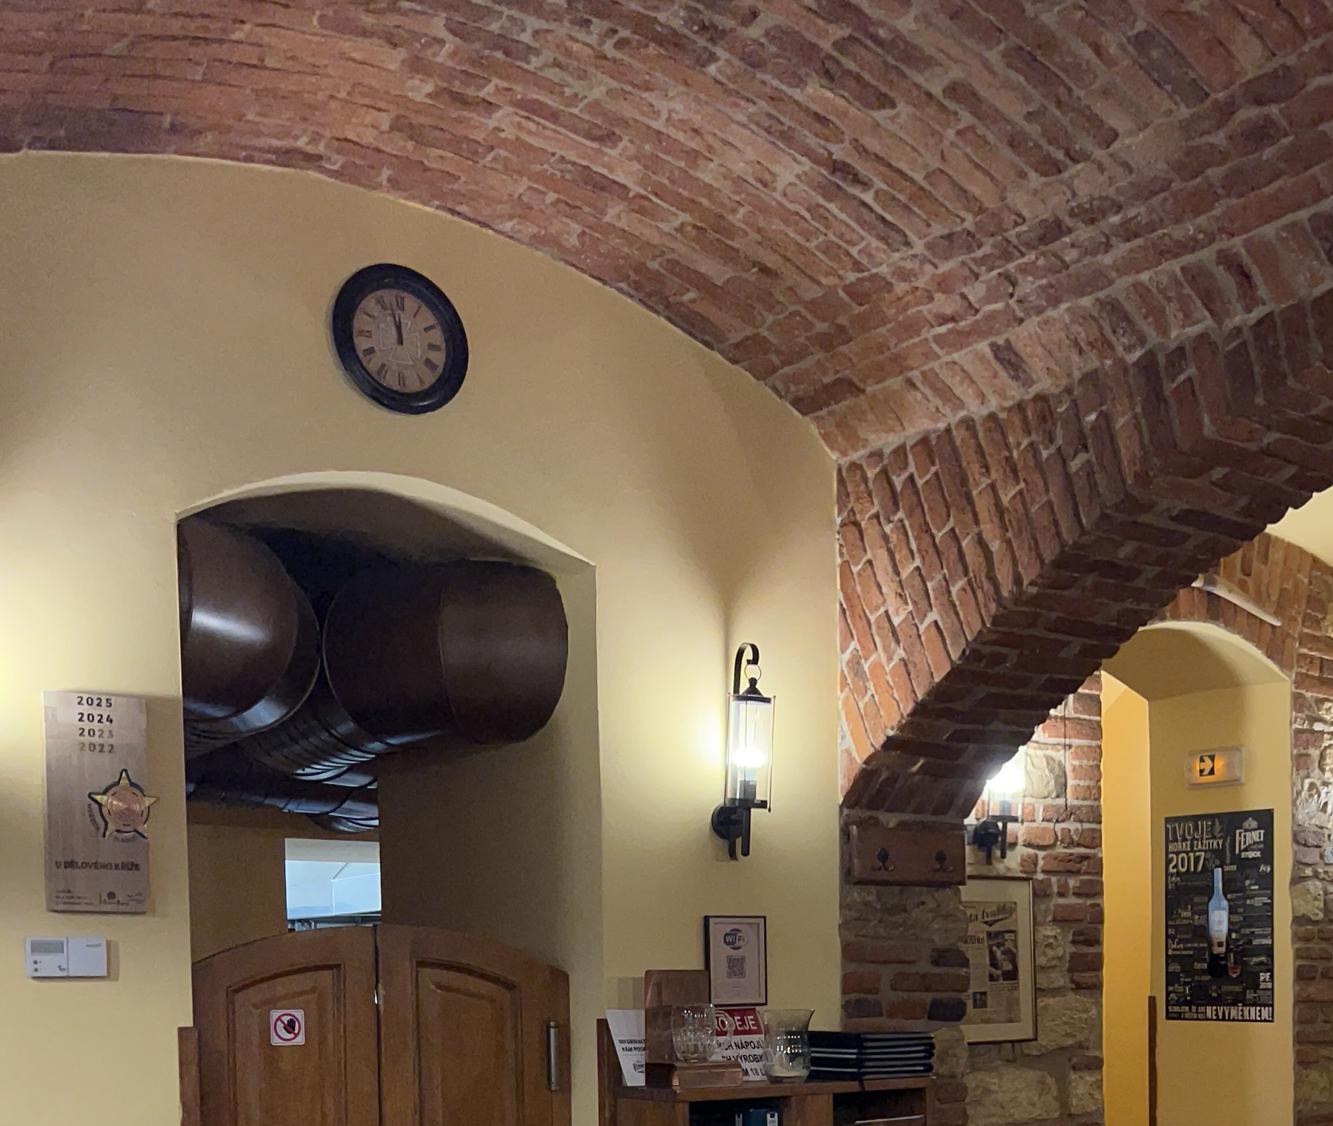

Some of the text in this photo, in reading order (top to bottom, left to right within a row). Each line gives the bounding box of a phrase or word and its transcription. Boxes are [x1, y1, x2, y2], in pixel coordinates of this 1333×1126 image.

[77, 696, 113, 708] 2025
[77, 712, 113, 724] 2024
[80, 742, 114, 754] 2022
[1166, 820, 1212, 841] TVOJE
[1235, 829, 1265, 855] FERNET
[1168, 852, 1205, 873] 2017
[1206, 1003, 1272, 1020] NEVYMĚKNEM!
